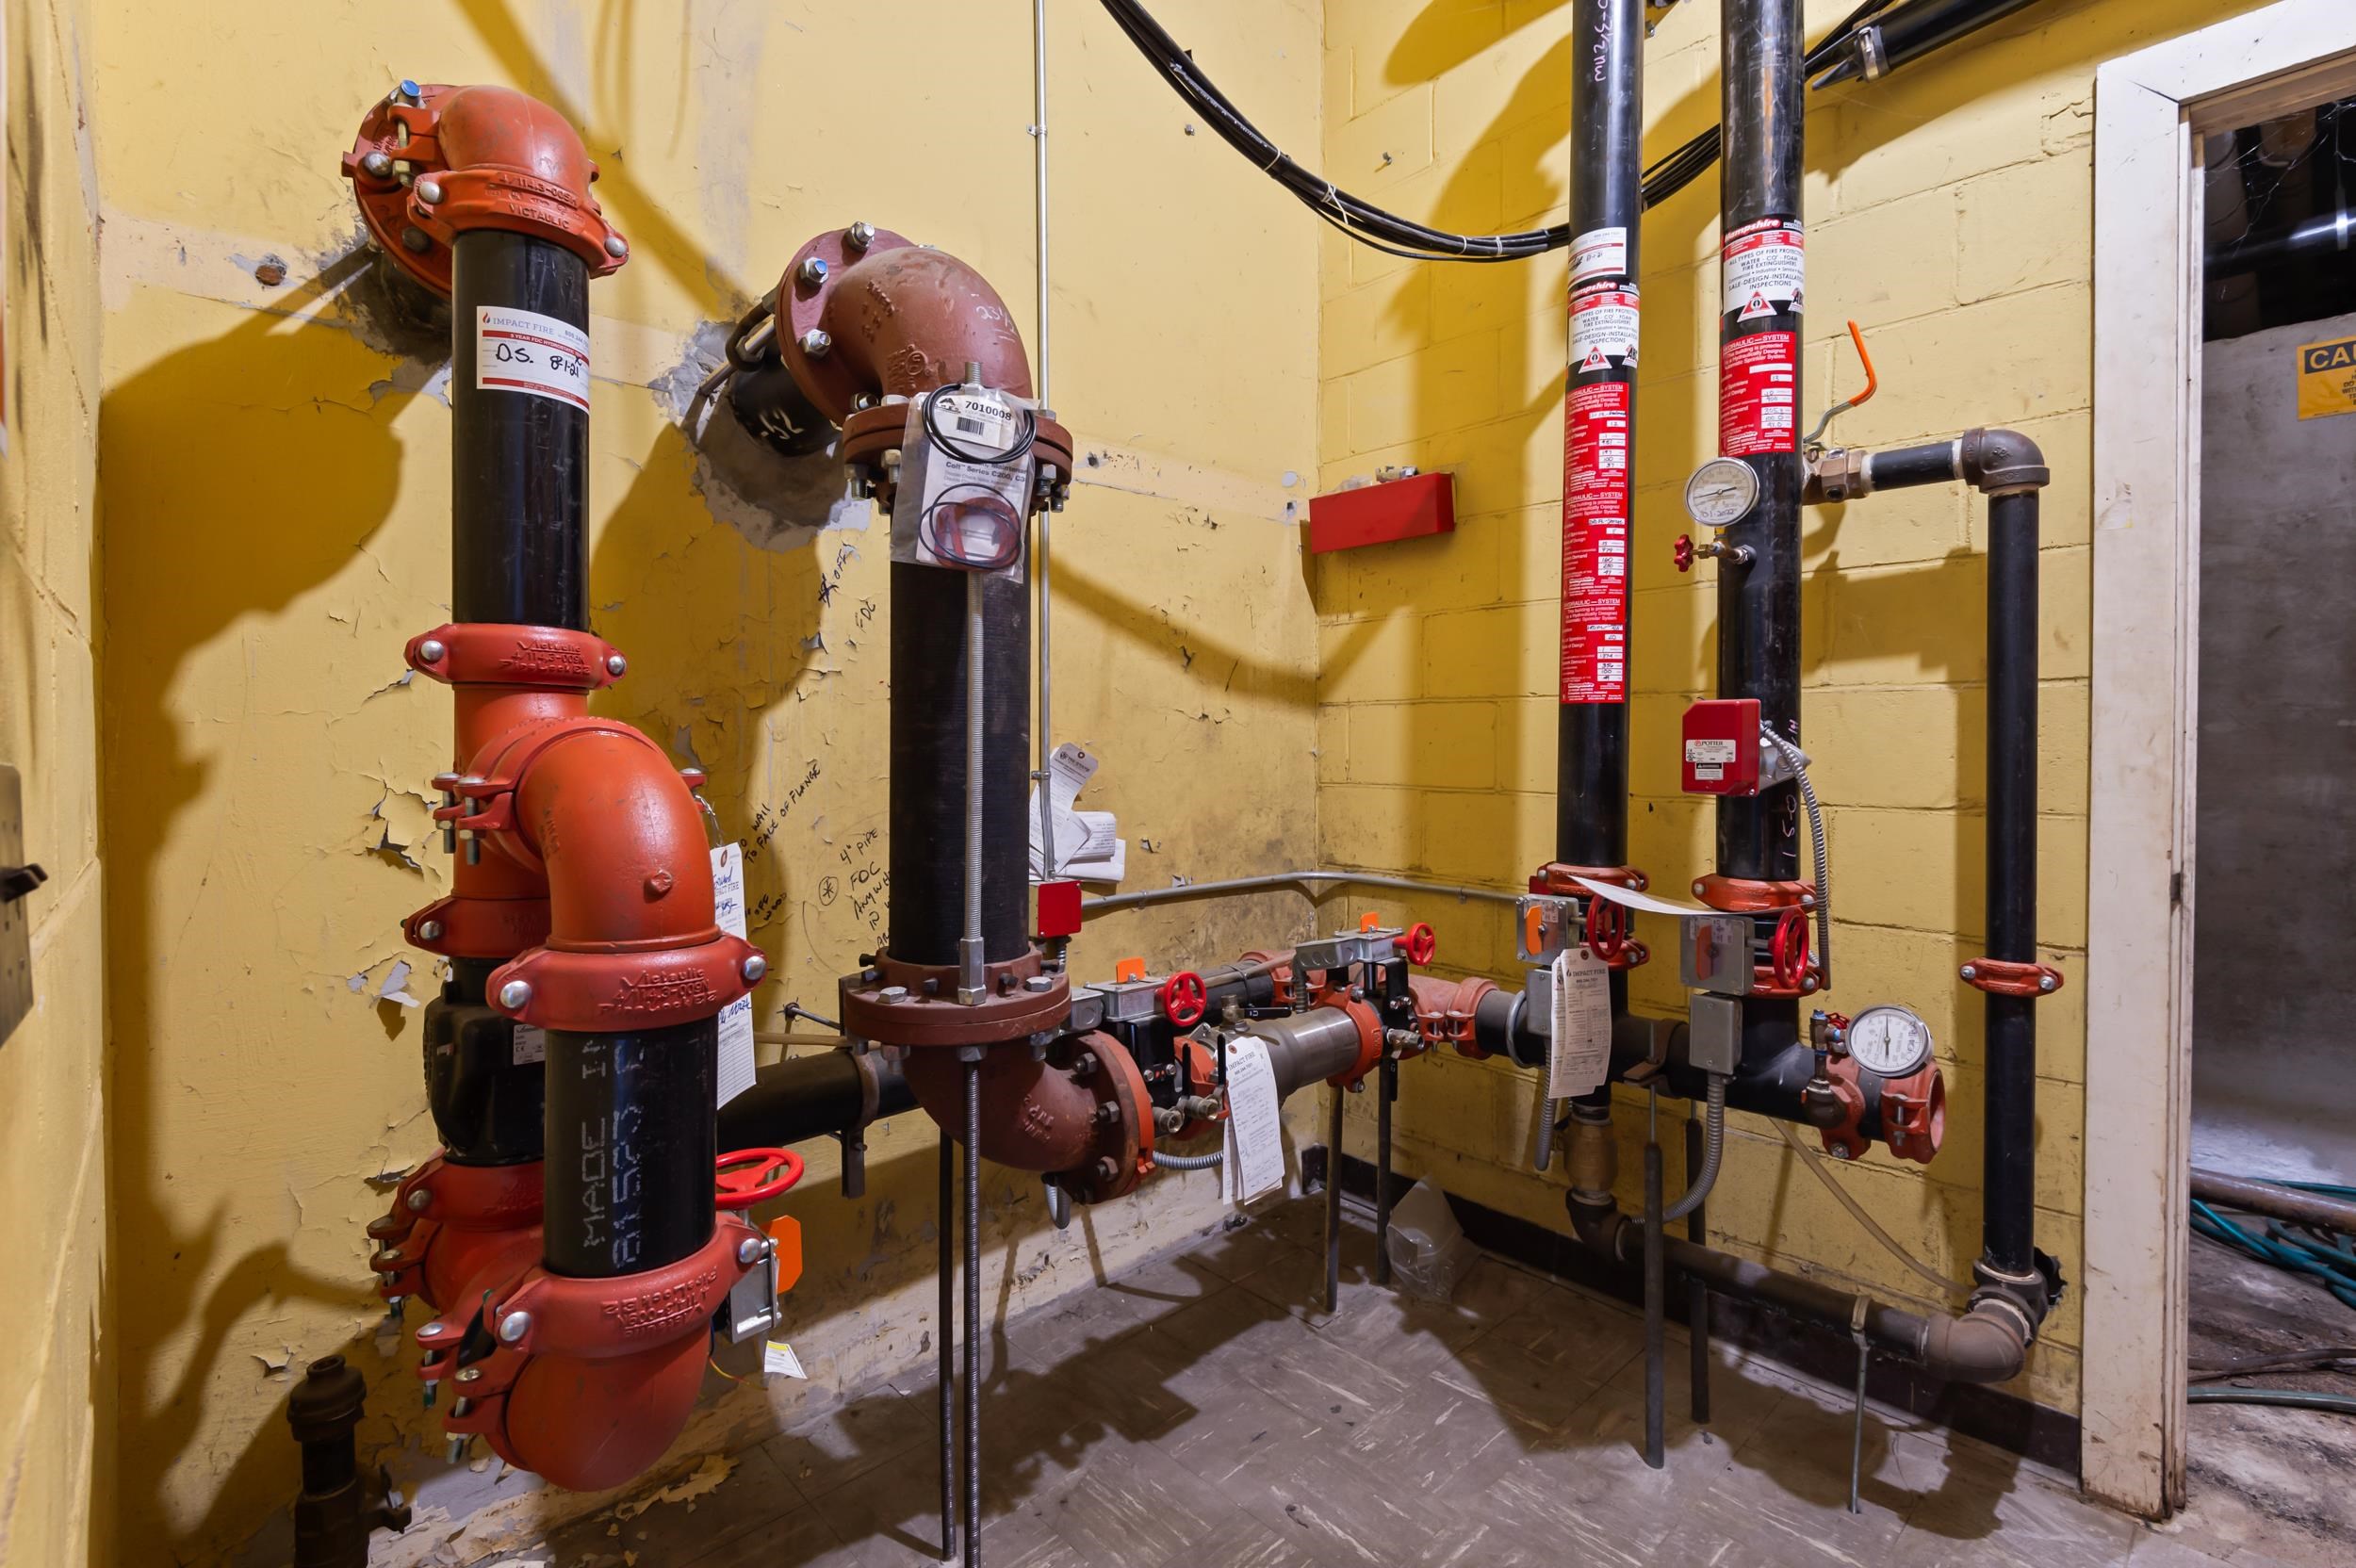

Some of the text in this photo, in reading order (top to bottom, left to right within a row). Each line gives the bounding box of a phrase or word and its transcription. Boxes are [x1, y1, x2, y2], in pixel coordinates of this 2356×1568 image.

[509, 203, 569, 229] VICTAULIC
[1738, 253, 1755, 263] TYPES
[1741, 257, 1759, 268] WATER
[1742, 263, 1754, 271] FIRE
[1749, 280, 1792, 290] INSPECTIONS
[493, 317, 554, 335] IMPACT FIRE
[1582, 316, 1599, 324] WATER
[2310, 344, 2356, 368] CA
[964, 400, 1012, 421] 7010008
[967, 466, 990, 476] Series
[516, 640, 581, 654] Victaulic
[780, 801, 790, 817] OF
[789, 763, 821, 804] FLANGE
[728, 881, 740, 892] FIRE
[622, 967, 705, 987] Victaulic
[1228, 1054, 1246, 1071] IMPACT
[1245, 1051, 1255, 1062] FIRE
[581, 1118, 605, 1247] MADE
